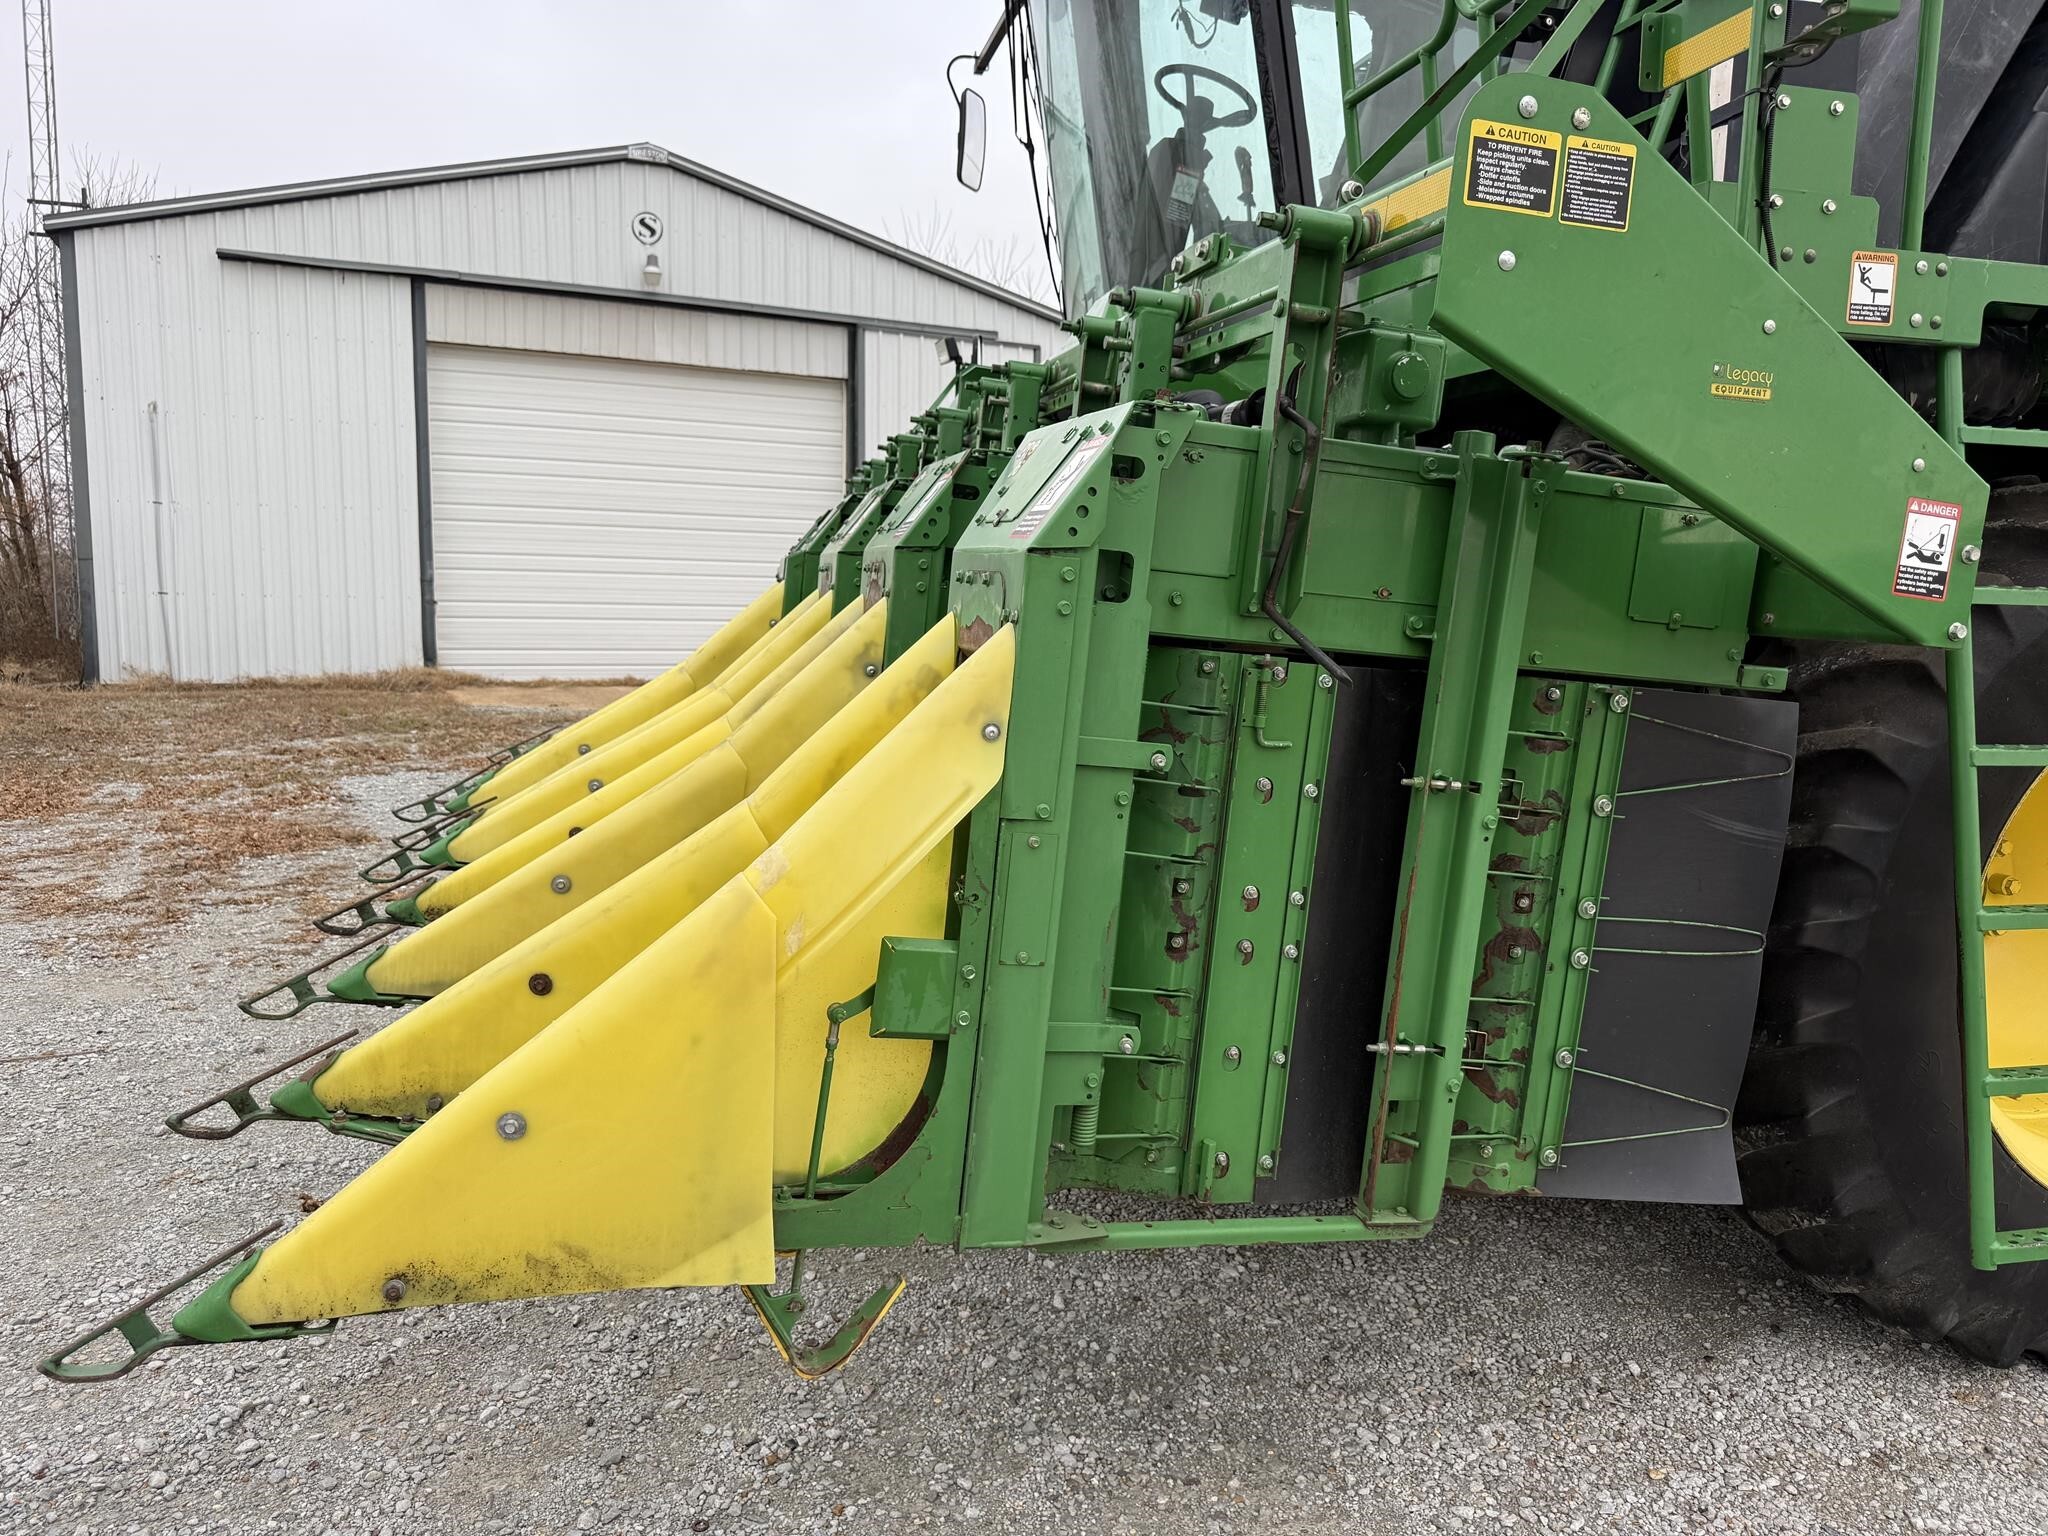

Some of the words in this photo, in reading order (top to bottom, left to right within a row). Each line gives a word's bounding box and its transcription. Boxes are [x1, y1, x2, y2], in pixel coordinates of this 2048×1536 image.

[1498, 128, 1547, 144] CAUTION
[1498, 144, 1528, 154] PREVENT
[1528, 148, 1542, 156] FIRE
[1592, 142, 1620, 152] CAUTION
[1476, 155, 1498, 164] Inspect
[1499, 160, 1527, 170] regularly.
[1477, 148, 1492, 157] Keep
[1494, 151, 1515, 161] picking
[1517, 155, 1532, 163] units
[1533, 158, 1550, 166] clean.
[1479, 163, 1500, 173] Always
[1501, 168, 1521, 176] check:
[1500, 174, 1520, 183] cutoffs
[1506, 183, 1528, 191] suction
[1530, 186, 1546, 194] doors
[1506, 197, 1530, 206] spindles
[1509, 191, 1534, 200] columns
[639, 217, 657, 238] S
[1862, 254, 1895, 262] WARNING
[1727, 364, 1773, 387] Legacy
[1715, 385, 1767, 397] EQUIPMENT
[1921, 503, 1958, 517] DANGER
